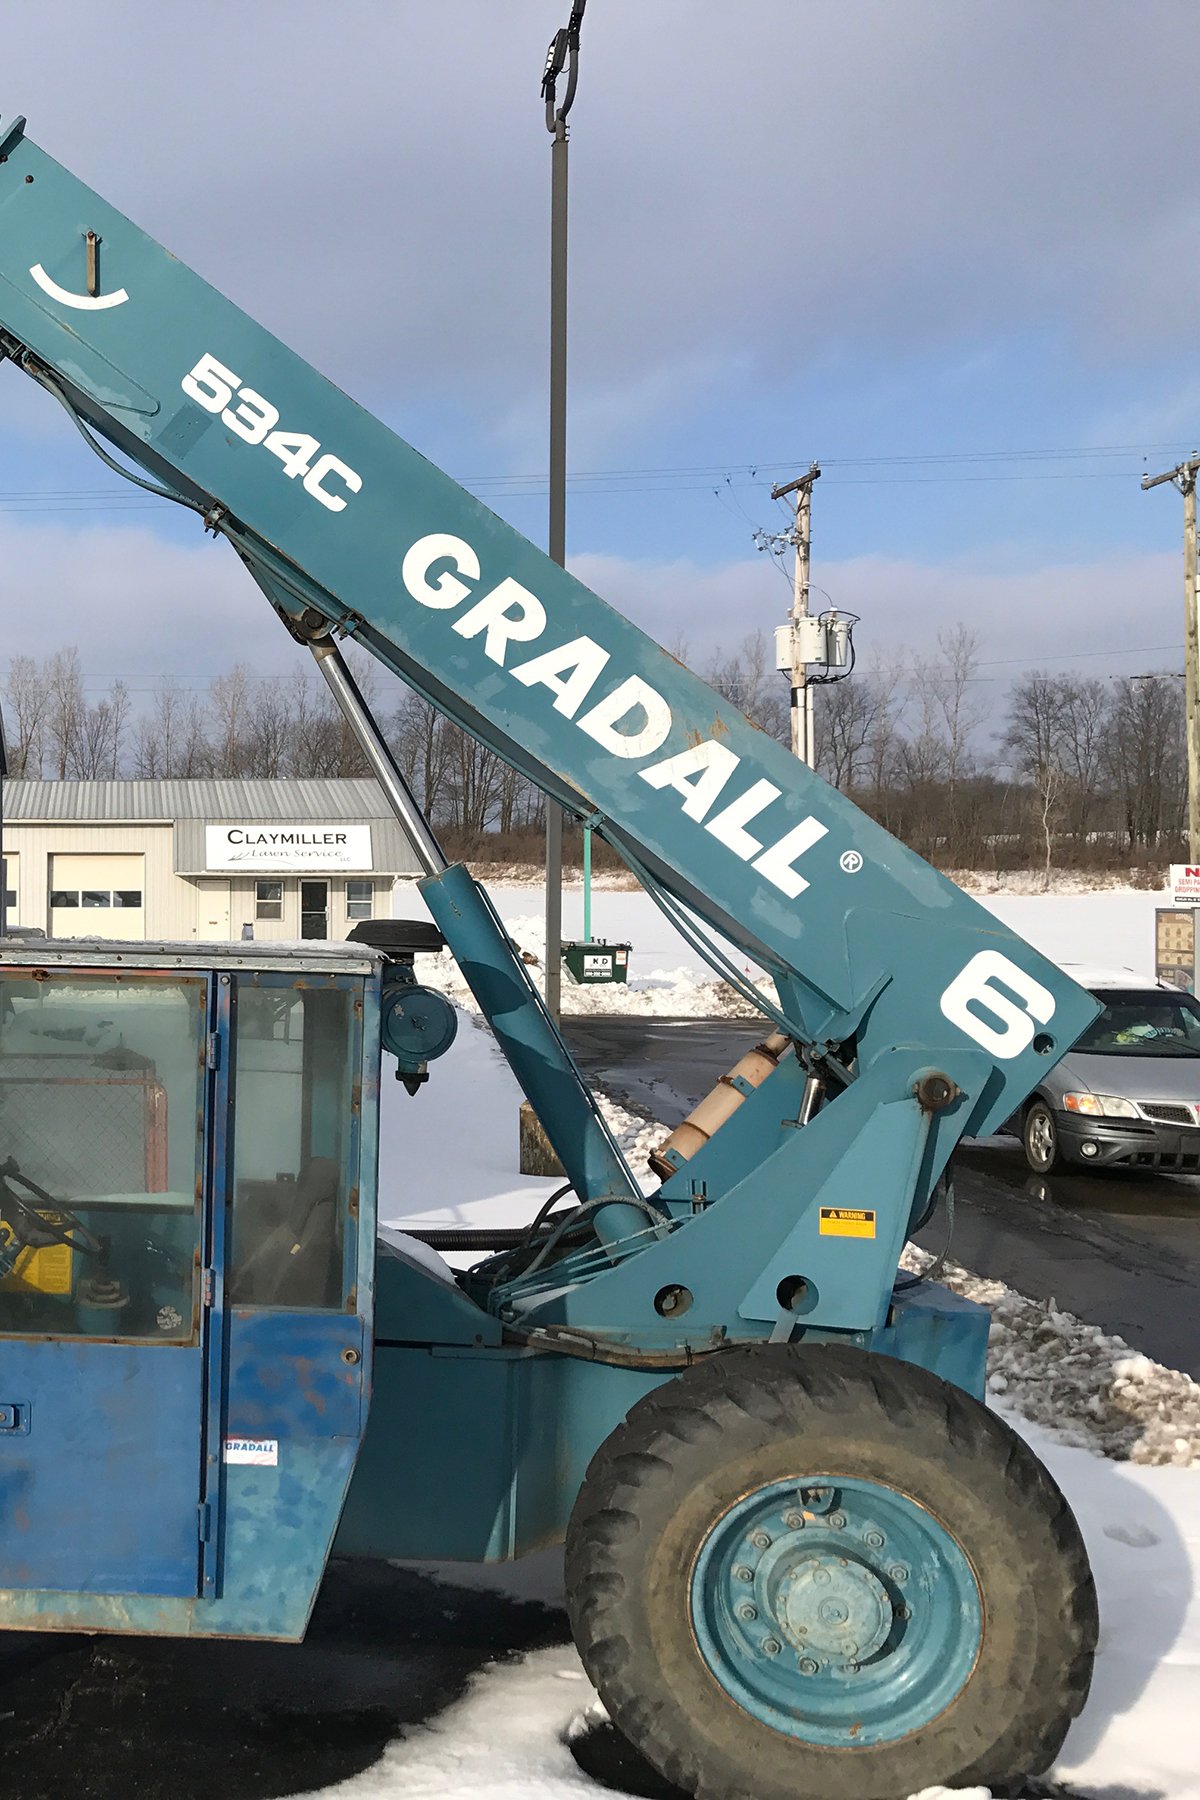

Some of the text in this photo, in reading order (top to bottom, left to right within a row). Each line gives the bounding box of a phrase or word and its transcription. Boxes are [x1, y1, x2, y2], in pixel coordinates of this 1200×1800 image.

[181, 352, 363, 513] 534C
[402, 533, 830, 899] GRADALL
[227, 829, 347, 844] CLAYMILLER
[294, 849, 344, 857] Service
[940, 949, 1056, 1059] 6
[838, 1210, 866, 1220] WARNING
[225, 1442, 274, 1453] GRADALL
